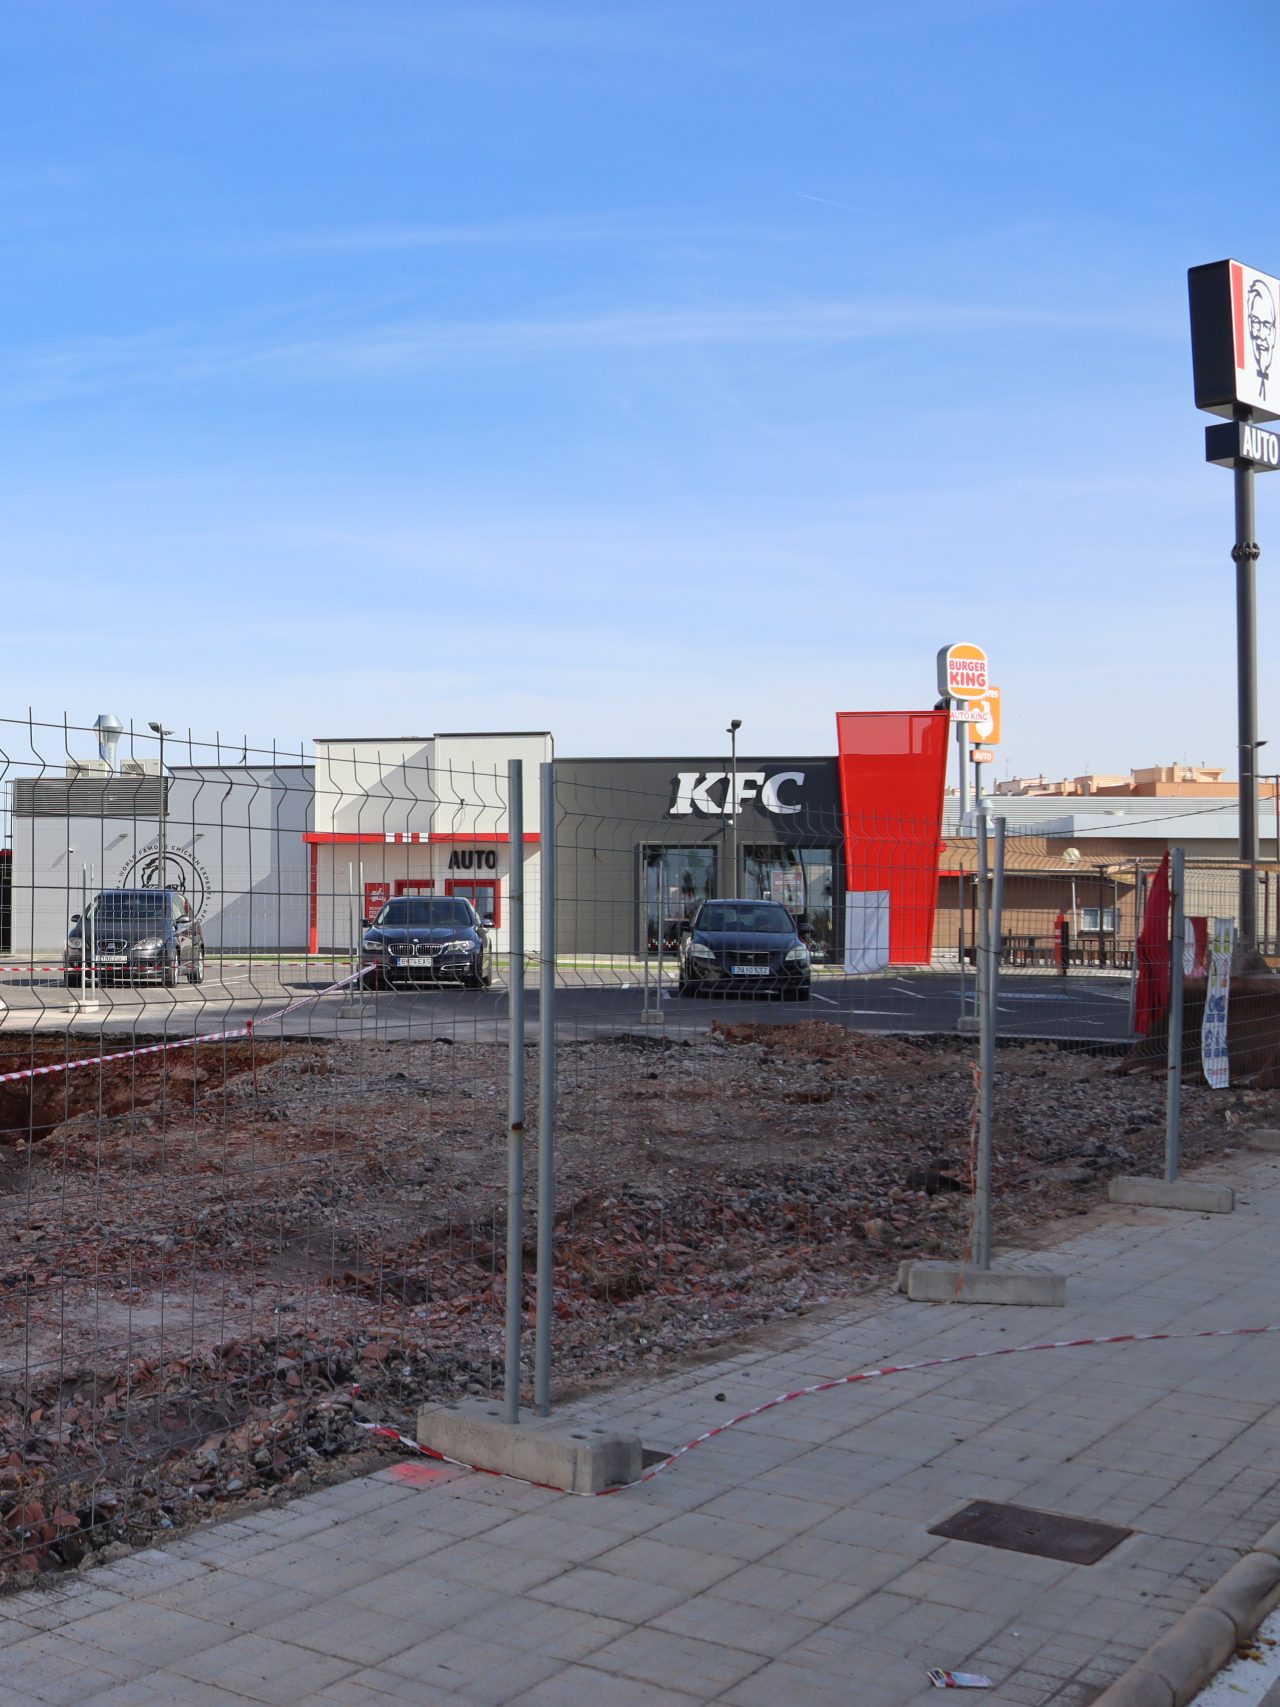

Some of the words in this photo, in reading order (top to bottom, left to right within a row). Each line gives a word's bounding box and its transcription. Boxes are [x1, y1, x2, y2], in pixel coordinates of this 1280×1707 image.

[1243, 425, 1279, 465] AUTO
[949, 660, 986, 672] BURGER
[949, 671, 986, 687] KING
[950, 711, 970, 720] AUTO
[970, 712, 988, 721] KING
[974, 752, 992, 761] AUTO
[669, 771, 806, 815] KFC
[448, 850, 496, 869] AUTO
[138, 843, 169, 856] FAMOS
[171, 845, 201, 866] CHICKEN
[199, 866, 213, 900] EXPERTS
